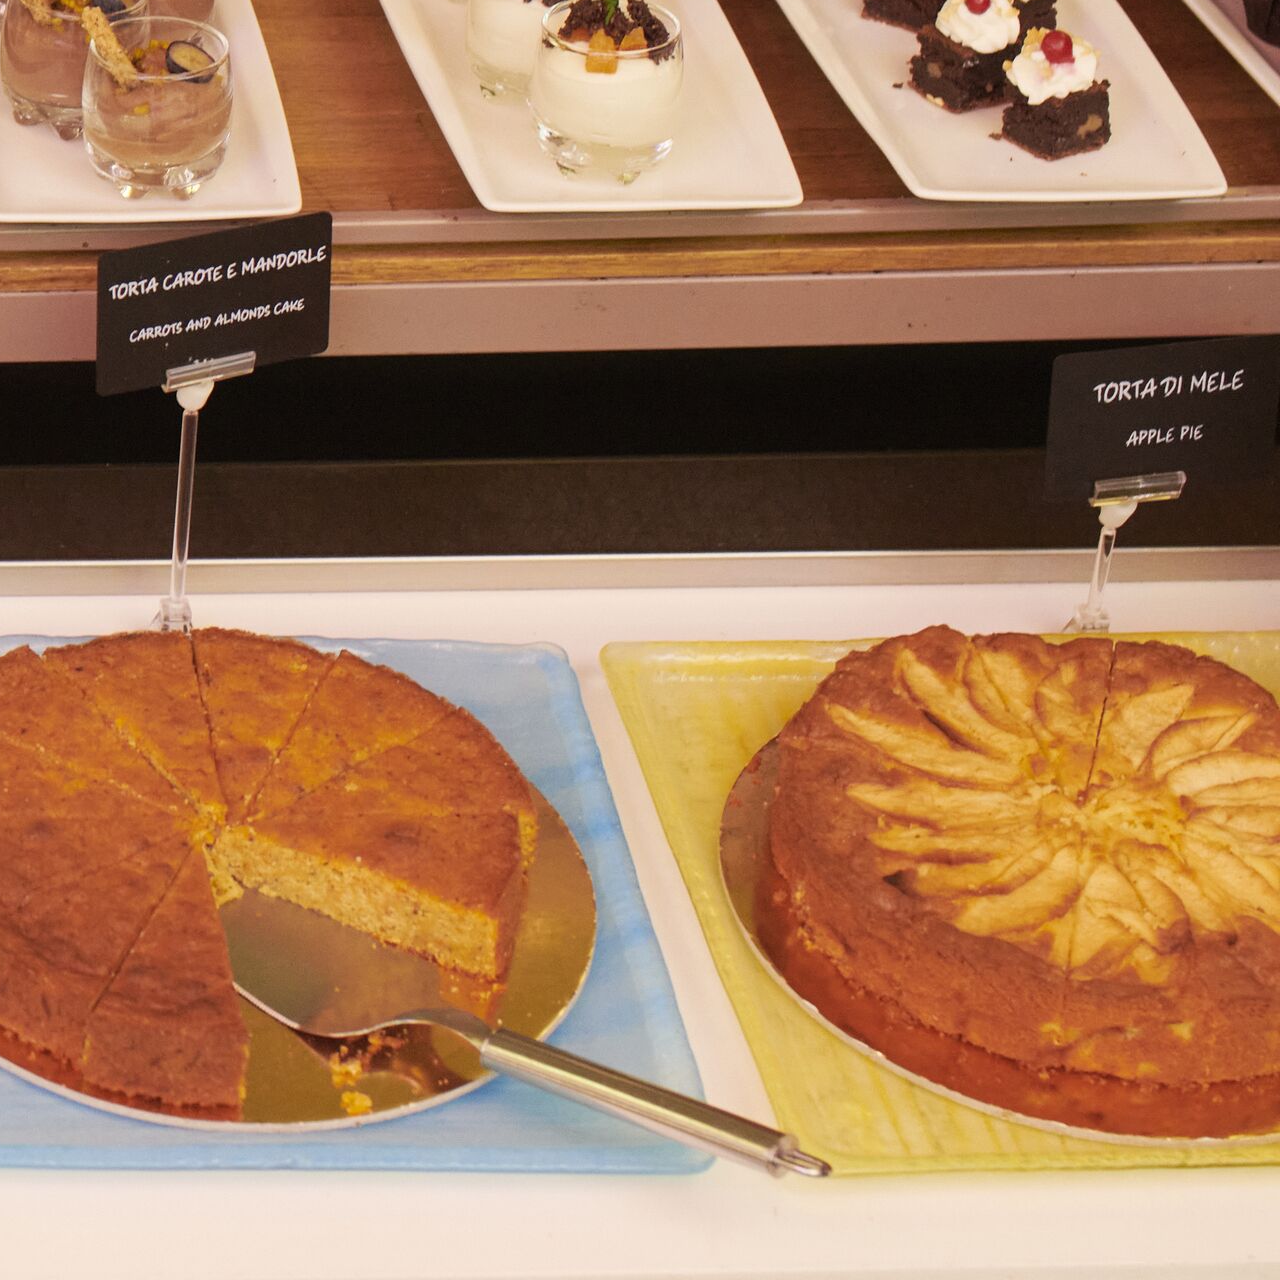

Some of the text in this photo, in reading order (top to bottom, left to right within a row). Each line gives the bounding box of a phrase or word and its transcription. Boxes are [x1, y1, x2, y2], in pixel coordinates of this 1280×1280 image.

[109, 246, 327, 300] TORTA CAROTE E MANDORLE
[129, 298, 305, 343] CARROTS AND ALMONDS CAKE
[1093, 369, 1244, 403] TORTA DI MELE
[1126, 425, 1203, 447] APPLE PIE
